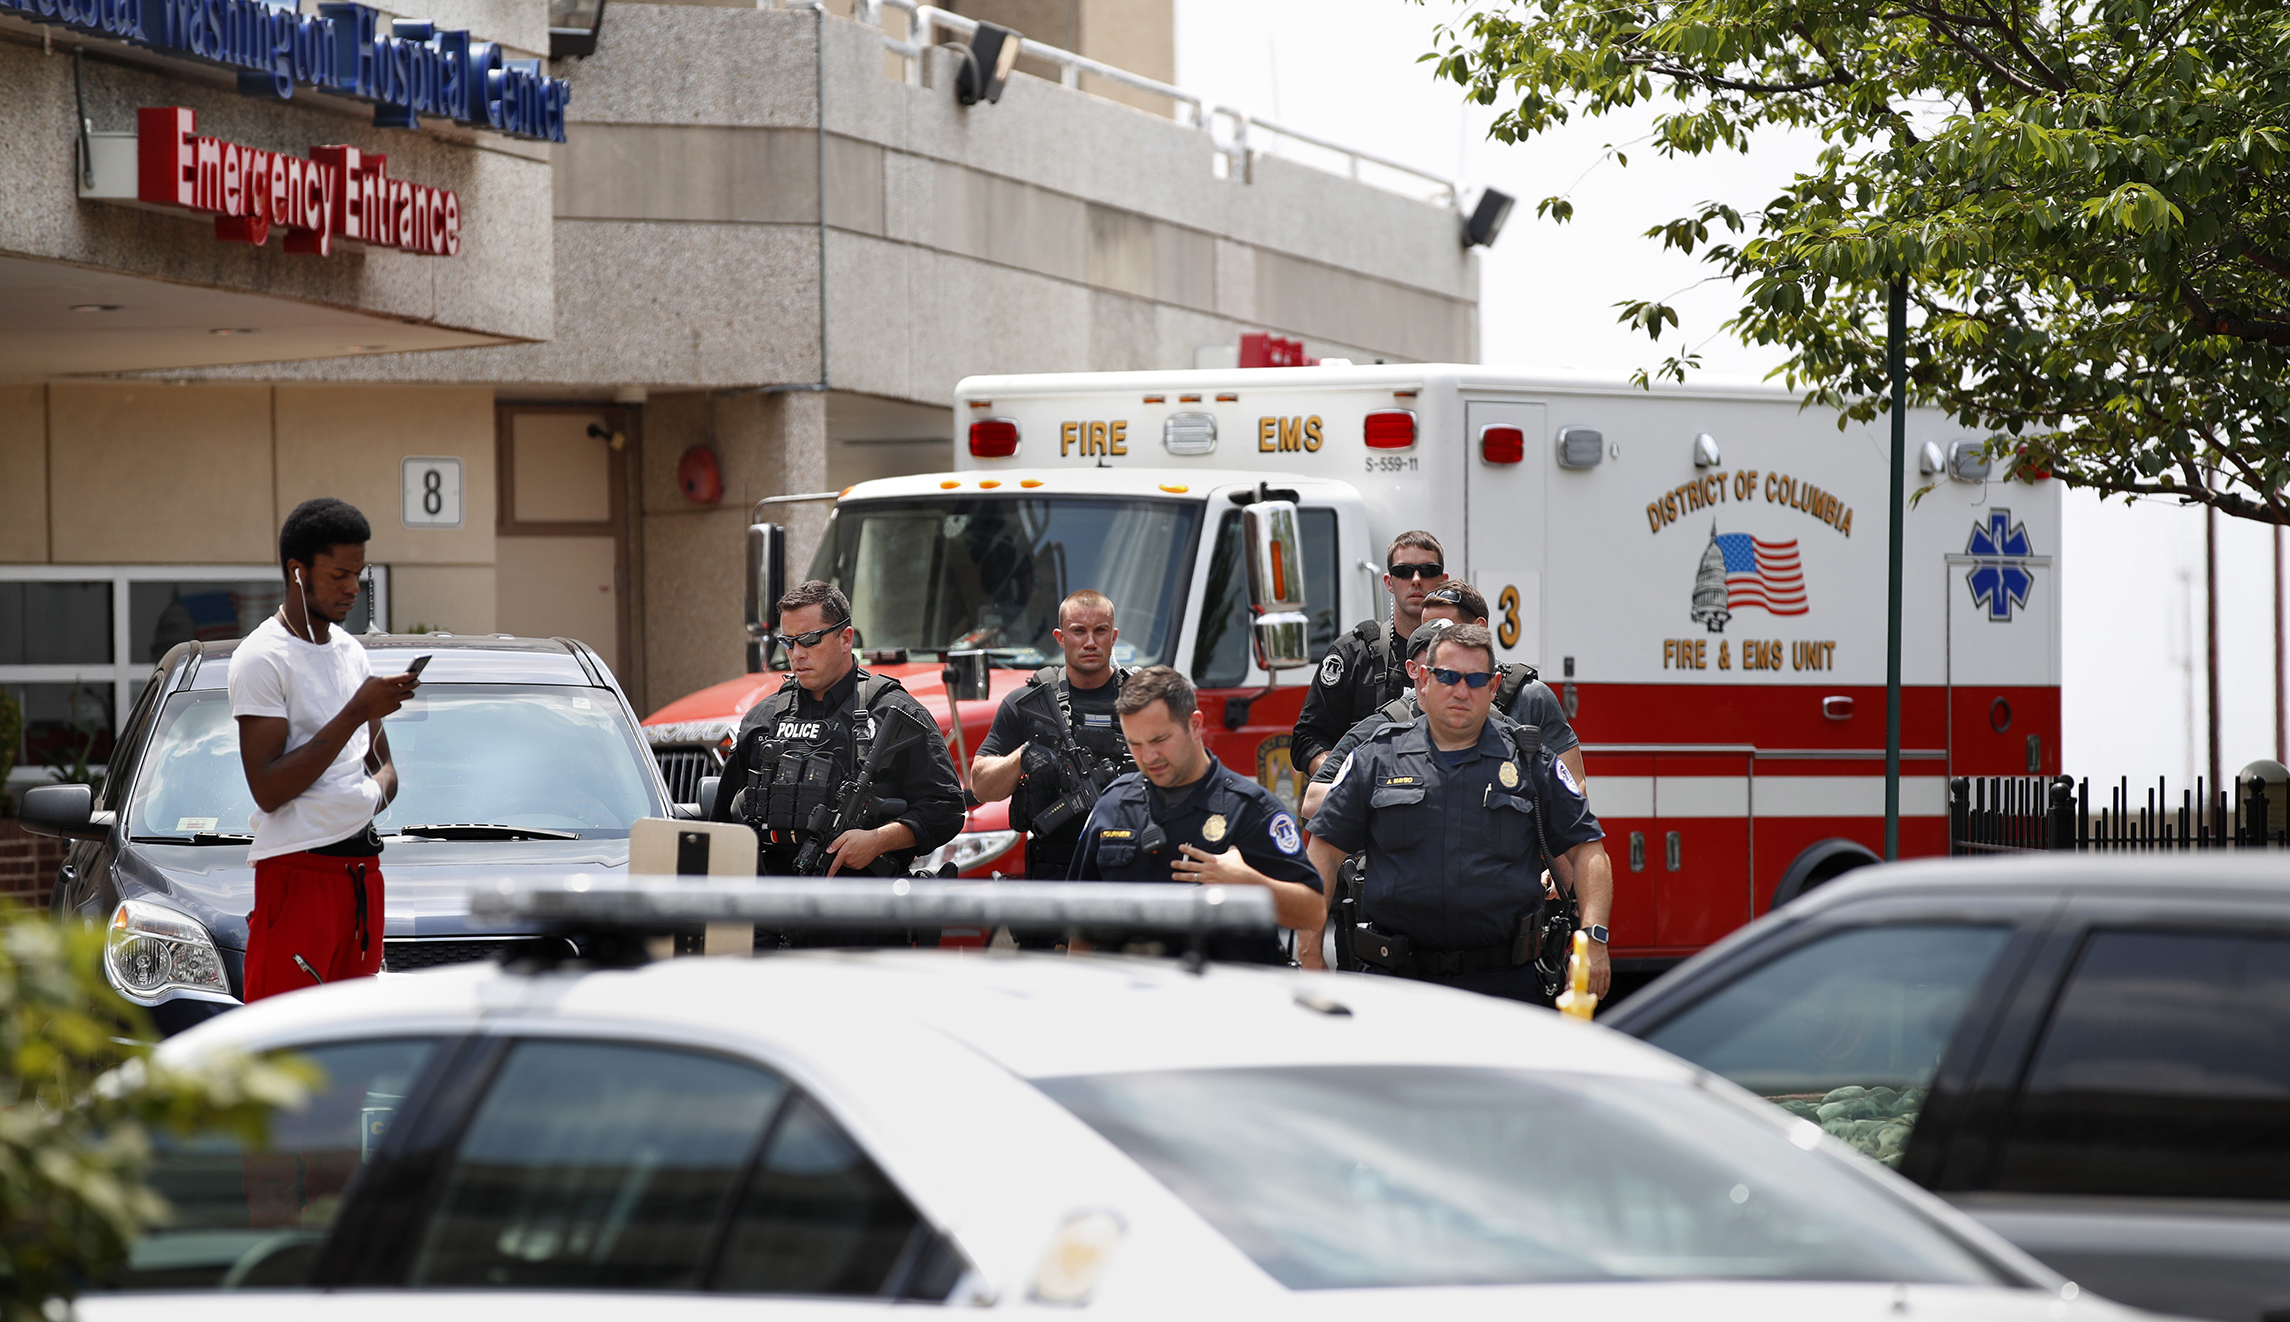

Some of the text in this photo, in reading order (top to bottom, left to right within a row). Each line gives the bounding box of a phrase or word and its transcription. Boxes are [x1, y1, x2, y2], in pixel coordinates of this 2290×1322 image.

[163, 0, 338, 99] Washington
[354, 5, 470, 130] Hospital
[484, 42, 571, 144] Center
[175, 106, 461, 257] Emergency Entrance
[1060, 414, 1324, 457] FIRE EMS
[1364, 456, 1419, 472] S-559-11
[423, 468, 442, 515] 8
[1647, 469, 1854, 538] DISTRICT OF COLUMBIA
[1497, 584, 1522, 650] 3
[1664, 638, 1837, 672] FIRE & EMS UNIT
[776, 722, 821, 739] POLICE
